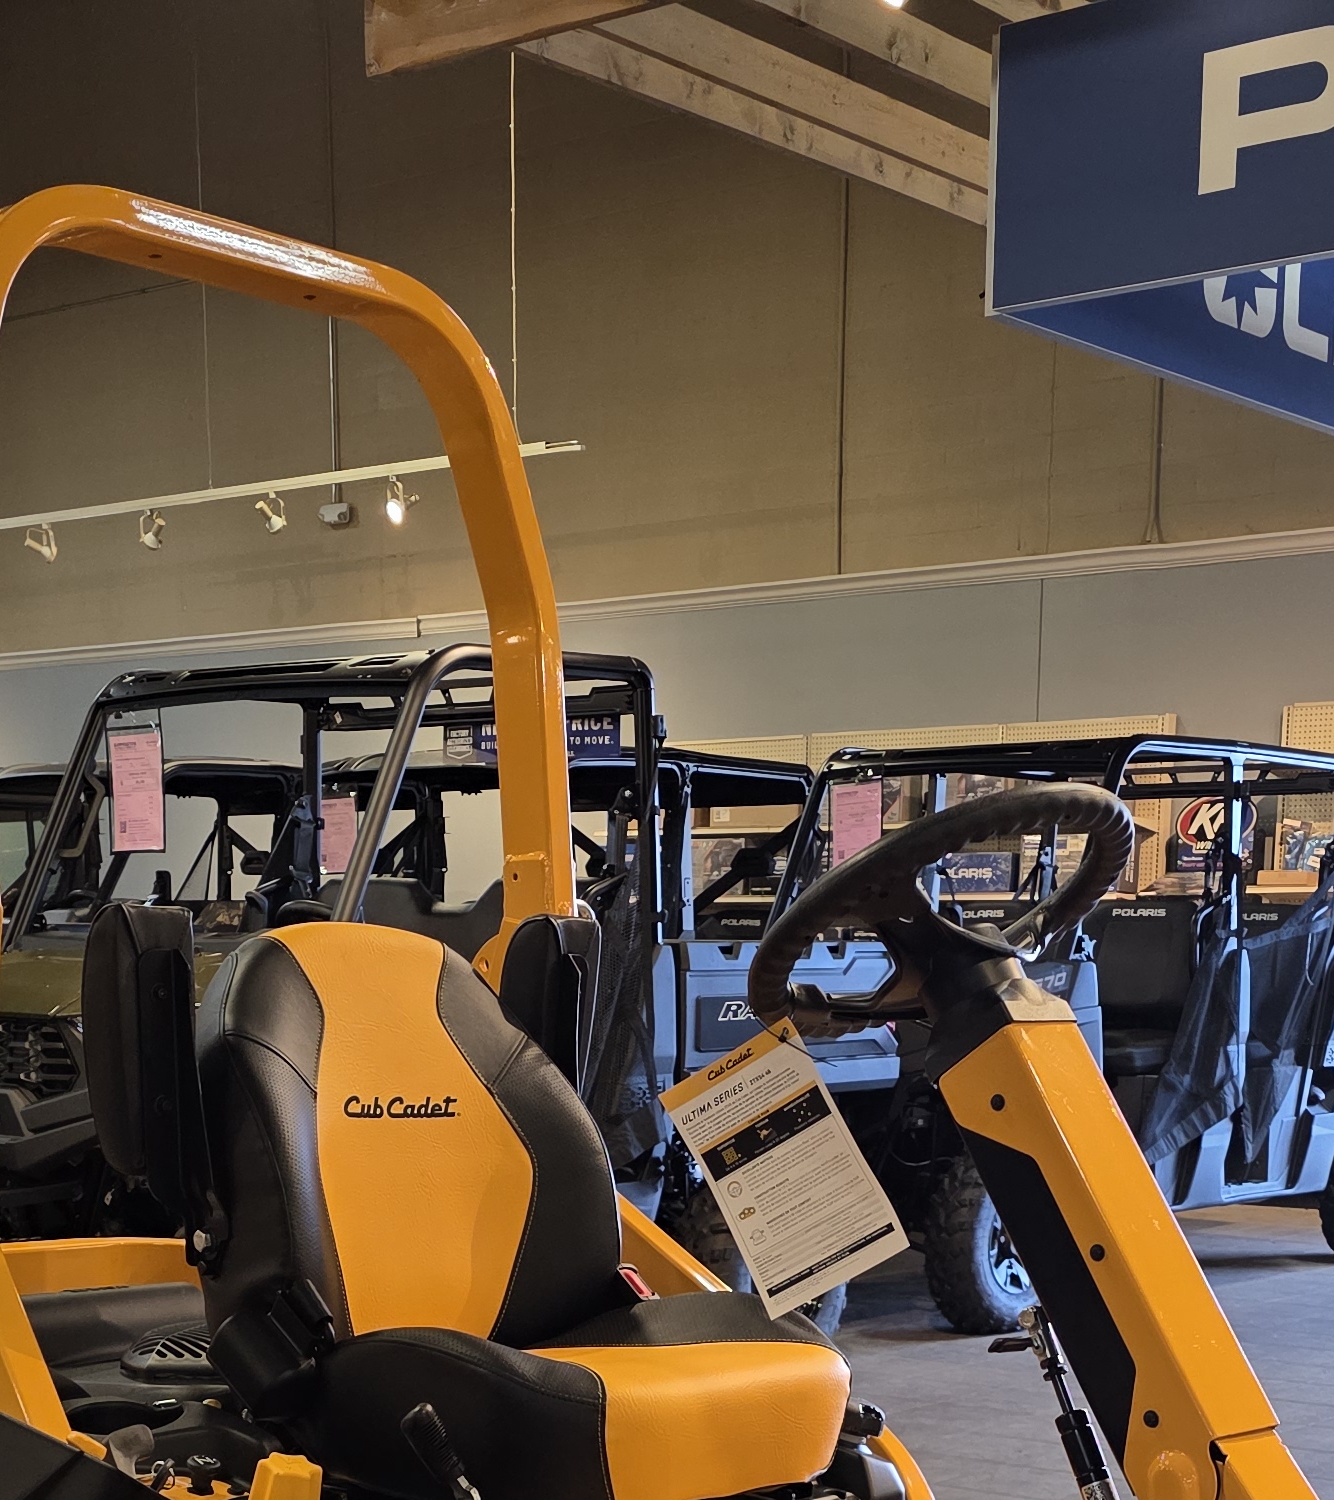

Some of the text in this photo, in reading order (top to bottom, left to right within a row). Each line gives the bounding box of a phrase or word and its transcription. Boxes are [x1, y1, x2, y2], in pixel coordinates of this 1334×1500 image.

[570, 736, 581, 745] TO
[1112, 908, 1166, 917] POLARIS
[1243, 913, 1278, 921] LARIS
[721, 919, 761, 927] POLARIS
[707, 1048, 755, 1081] Cub Cadet
[343, 1095, 457, 1118] Cub Cadet
[681, 1082, 744, 1126] ULTIMA SERIES
